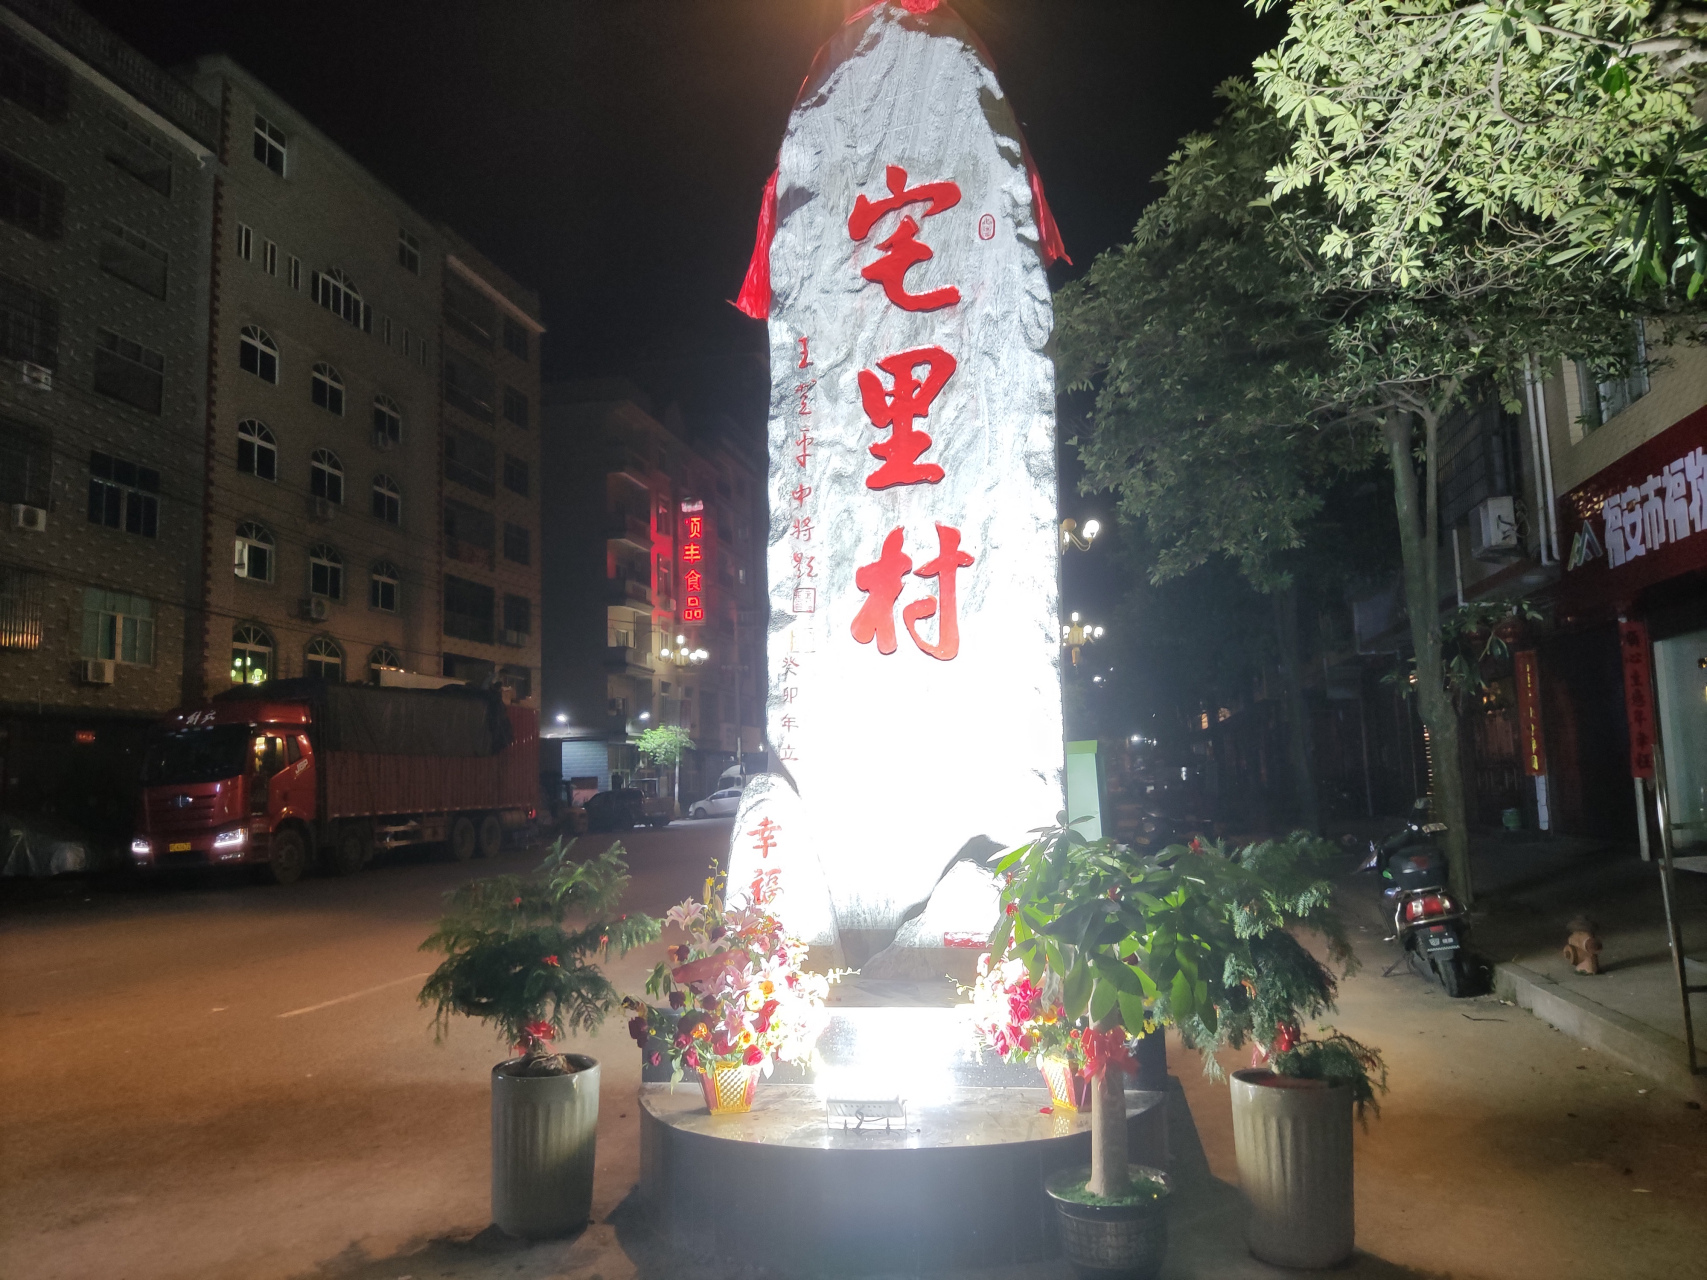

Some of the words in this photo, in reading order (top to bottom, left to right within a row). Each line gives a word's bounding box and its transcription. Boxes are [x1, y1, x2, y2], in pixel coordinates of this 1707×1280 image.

[848, 164, 977, 662] 宅里村
[780, 656, 800, 762] 癸卯年立
[747, 816, 784, 905] 幸福
